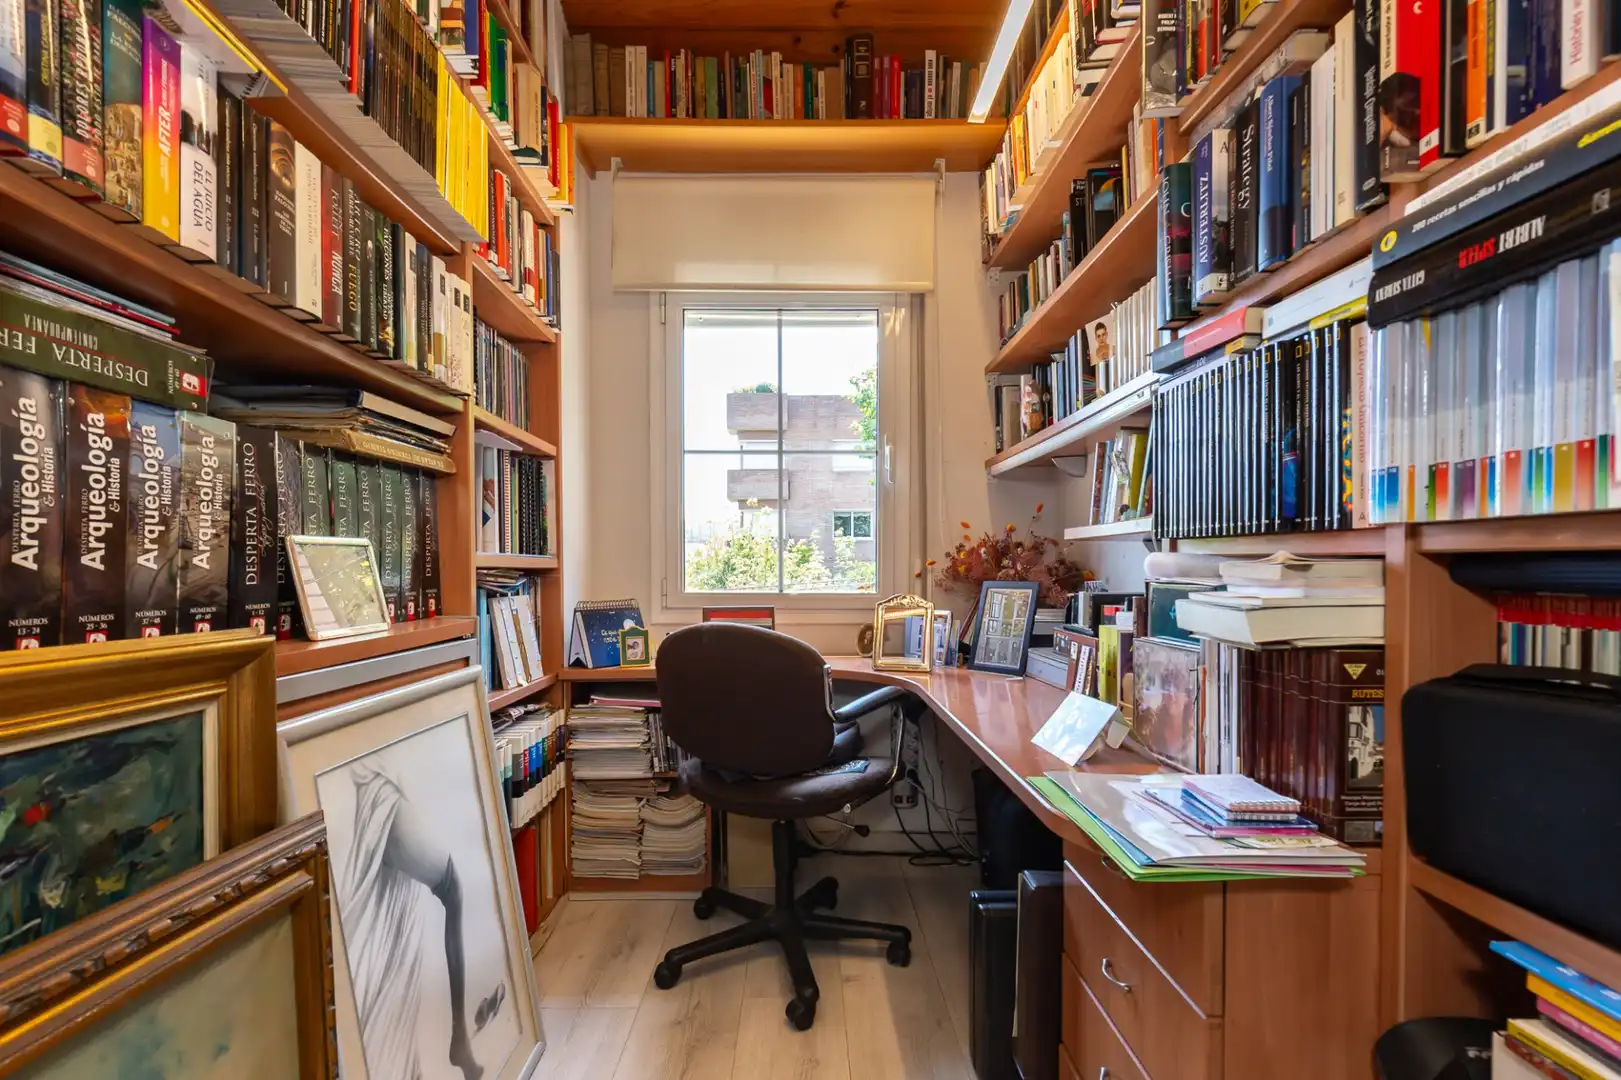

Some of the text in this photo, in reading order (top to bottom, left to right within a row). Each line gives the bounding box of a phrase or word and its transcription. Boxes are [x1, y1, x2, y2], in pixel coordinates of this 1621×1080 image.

[75, 17, 90, 139] DOLORES REDONDO
[158, 105, 173, 158] AFTER
[192, 160, 204, 187] DEL
[204, 169, 213, 186] EL
[1237, 123, 1256, 210] Strategy
[192, 188, 204, 228] AGUA
[203, 186, 213, 233] JUICIO
[331, 188, 341, 241] FOLLETT
[354, 192, 362, 261] ARTURO
[1199, 171, 1210, 264] AUSTERLITZ
[1457, 215, 1547, 269] ALBERT SPEER
[331, 250, 343, 297] NUNCA
[348, 263, 357, 312] FUEGO
[24, 313, 98, 350] CONTEMPORÁNEA
[52, 342, 149, 388] DESPERTA
[11, 397, 48, 571] Arqueología
[41, 447, 55, 507] & Historia
[80, 412, 113, 571] Arqueología
[108, 456, 121, 513] & Historia
[136, 424, 166, 570] Arqueología
[161, 465, 172, 517] & Historia
[212, 473, 223, 510] Historia
[306, 457, 316, 506] FERRO
[337, 464, 346, 508] FERRO
[361, 471, 371, 512] FERRO
[12, 479, 21, 552] DESPERTA FERRO
[192, 435, 219, 570] Arqueología
[243, 442, 258, 585] DESPERTA FERRO
[384, 473, 393, 579] DESPERTA FERRO
[403, 477, 413, 579] DESPERTA FERRO
[8, 617, 48, 627] NÚMEROS
[78, 614, 115, 624] NÚMEROS
[135, 609, 167, 618] NÚMEROS
[189, 606, 217, 614] NÚMEROS
[245, 602, 271, 610] NÚMEROS
[17, 627, 27, 636] 13
[31, 627, 40, 635] 24
